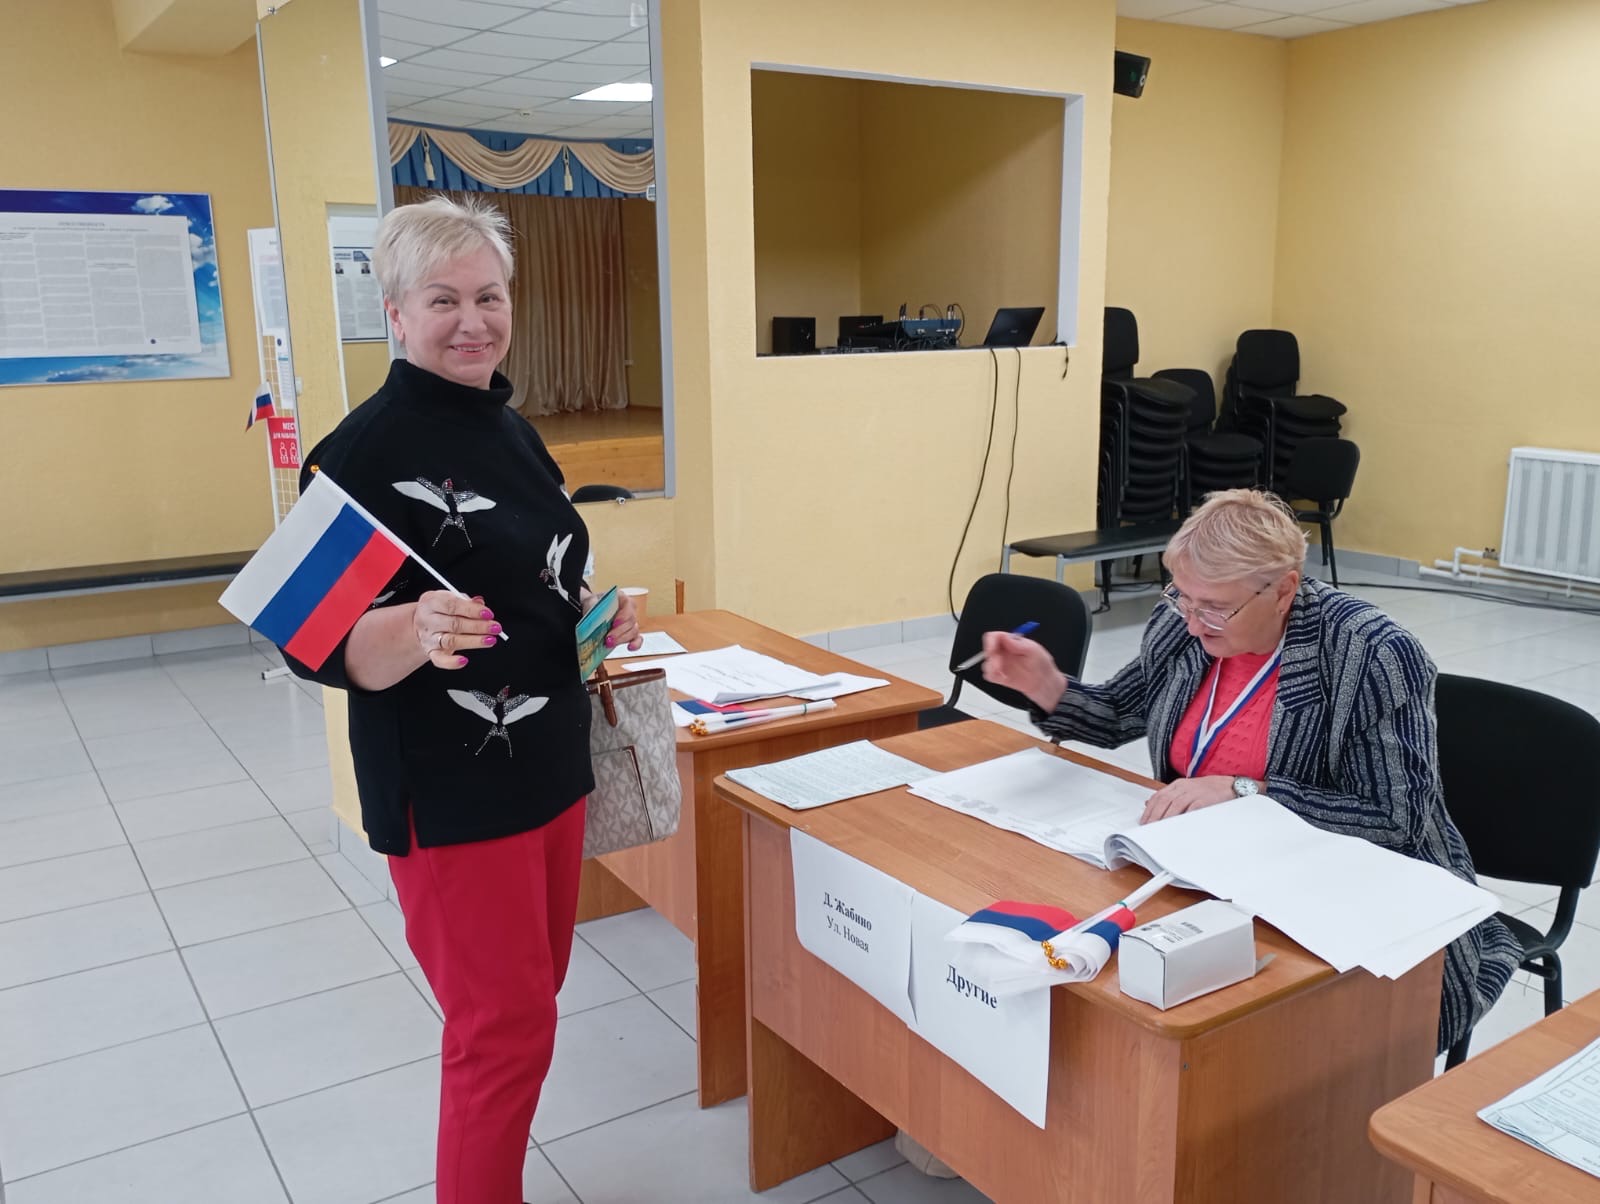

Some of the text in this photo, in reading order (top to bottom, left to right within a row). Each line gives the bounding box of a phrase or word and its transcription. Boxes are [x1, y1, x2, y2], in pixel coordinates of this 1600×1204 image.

[823, 891, 872, 931] Д. Жабино
[827, 915, 869, 953] Ул. Новая
[946, 963, 998, 1009] Другие
